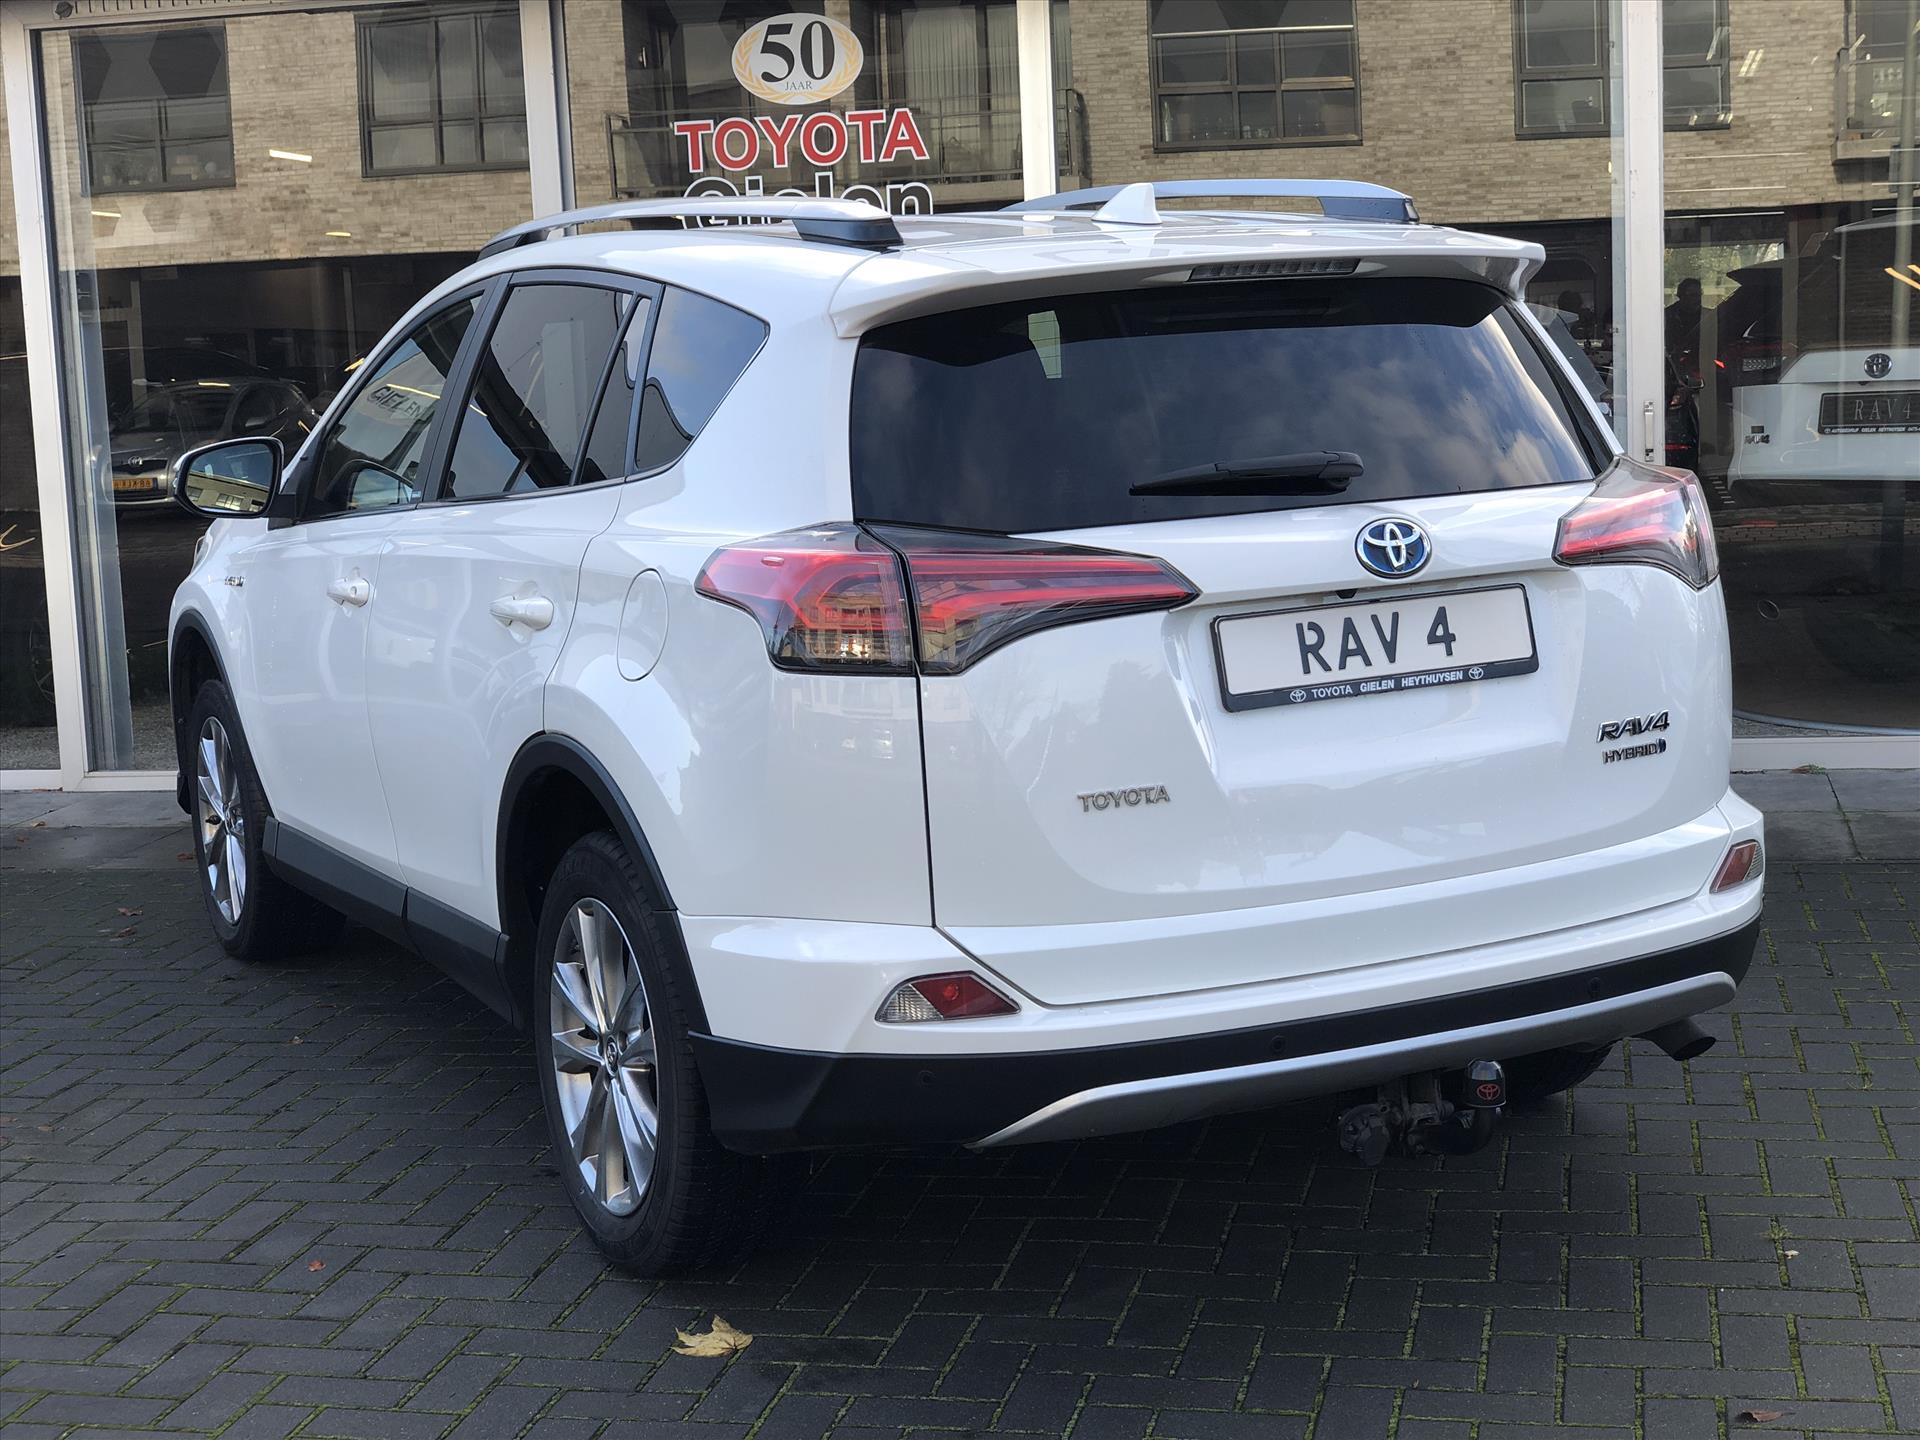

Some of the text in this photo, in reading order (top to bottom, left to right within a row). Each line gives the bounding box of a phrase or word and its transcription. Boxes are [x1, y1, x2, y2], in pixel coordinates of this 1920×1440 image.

[760, 20, 836, 83] 50
[784, 81, 813, 92] JAAR
[674, 108, 930, 173] TOYOTA
[1295, 606, 1456, 675] RAV 4
[1311, 671, 1463, 698] TOYOTA GIELEN HEYTHUYSEN
[1596, 709, 1670, 743] RAV4
[1602, 743, 1659, 764] HYBRID
[1077, 785, 1171, 812] TOYOTA
